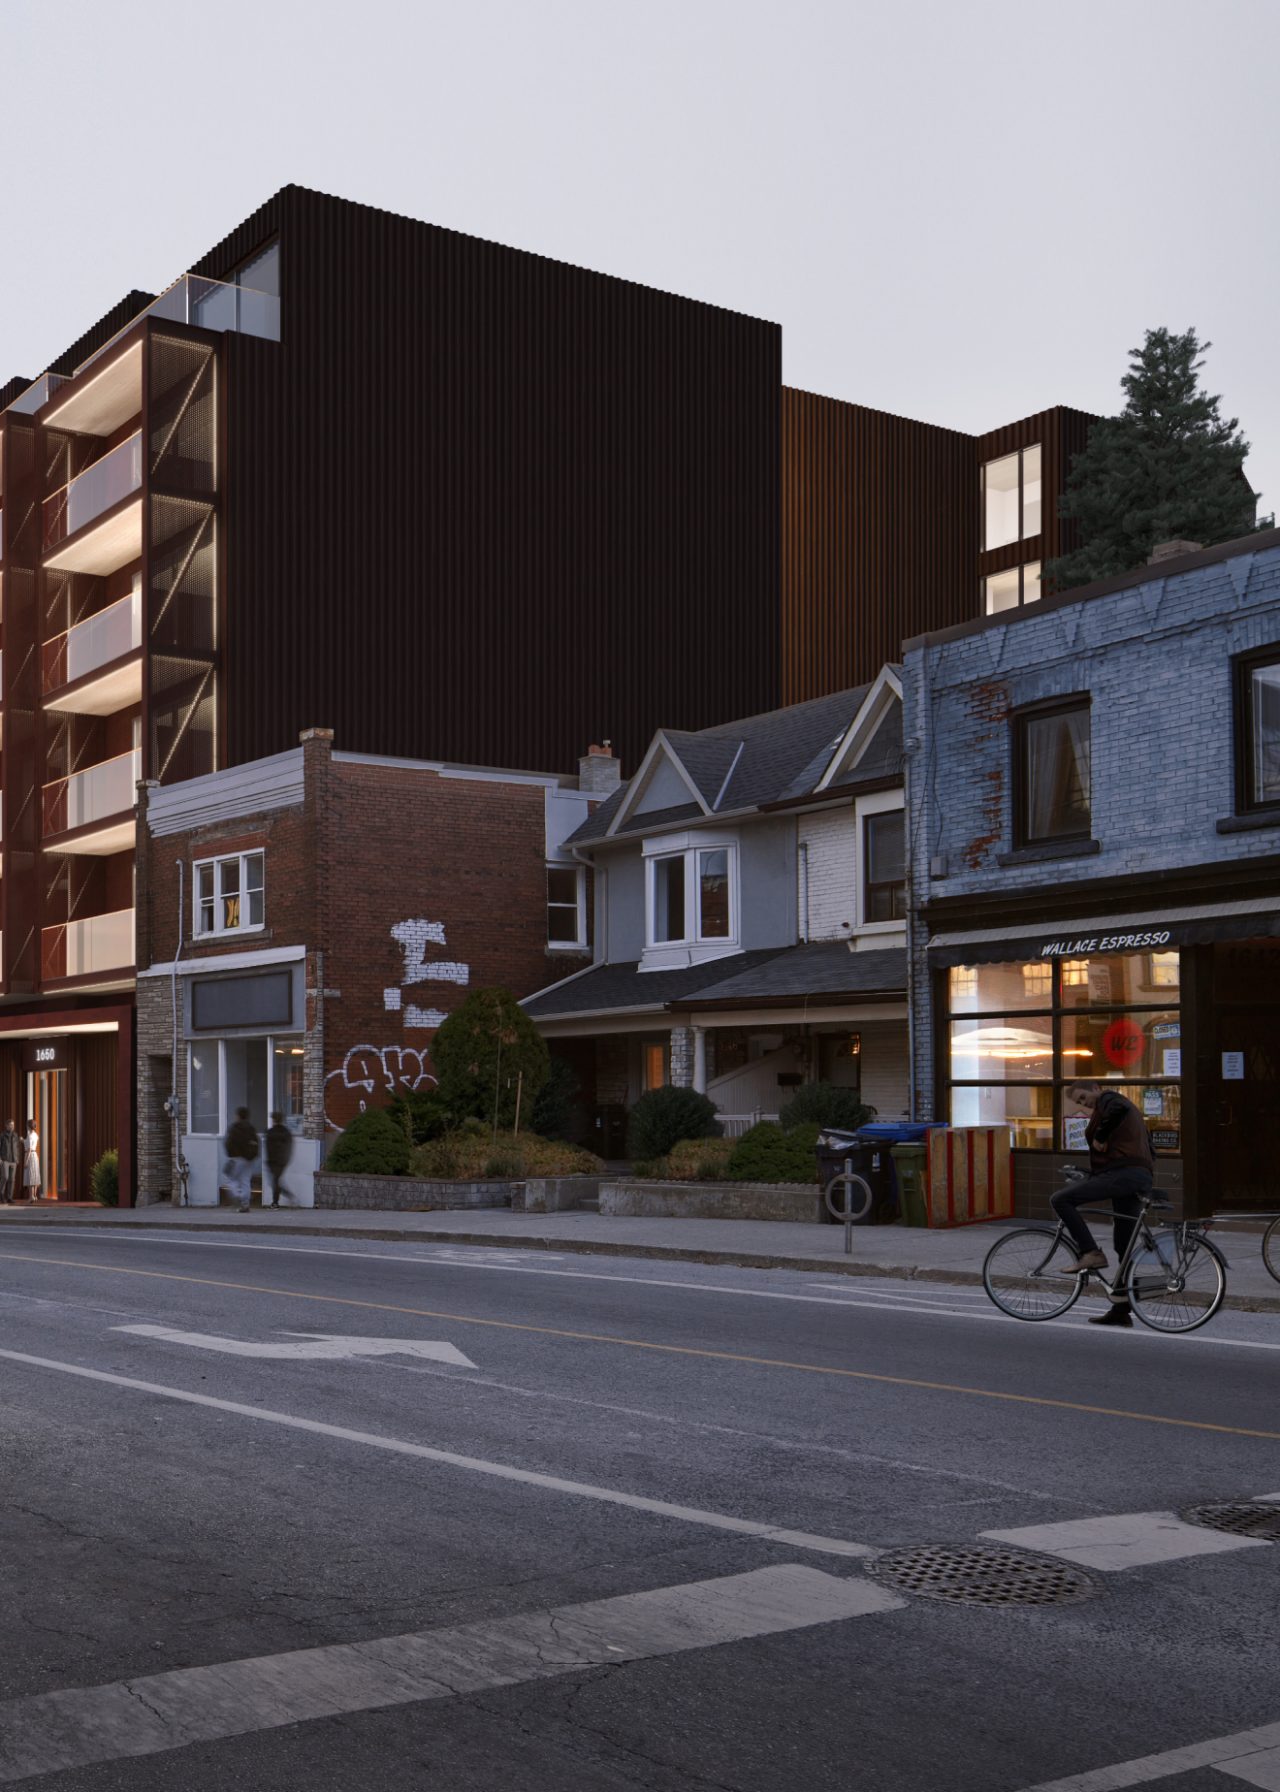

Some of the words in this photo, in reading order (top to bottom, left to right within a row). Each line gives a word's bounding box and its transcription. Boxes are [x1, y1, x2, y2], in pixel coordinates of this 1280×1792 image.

[1041, 938, 1098, 957] WALLACE
[1099, 931, 1171, 951] ESPRESSO
[1111, 1036, 1139, 1052] WE
[36, 1048, 55, 1061] 1650
